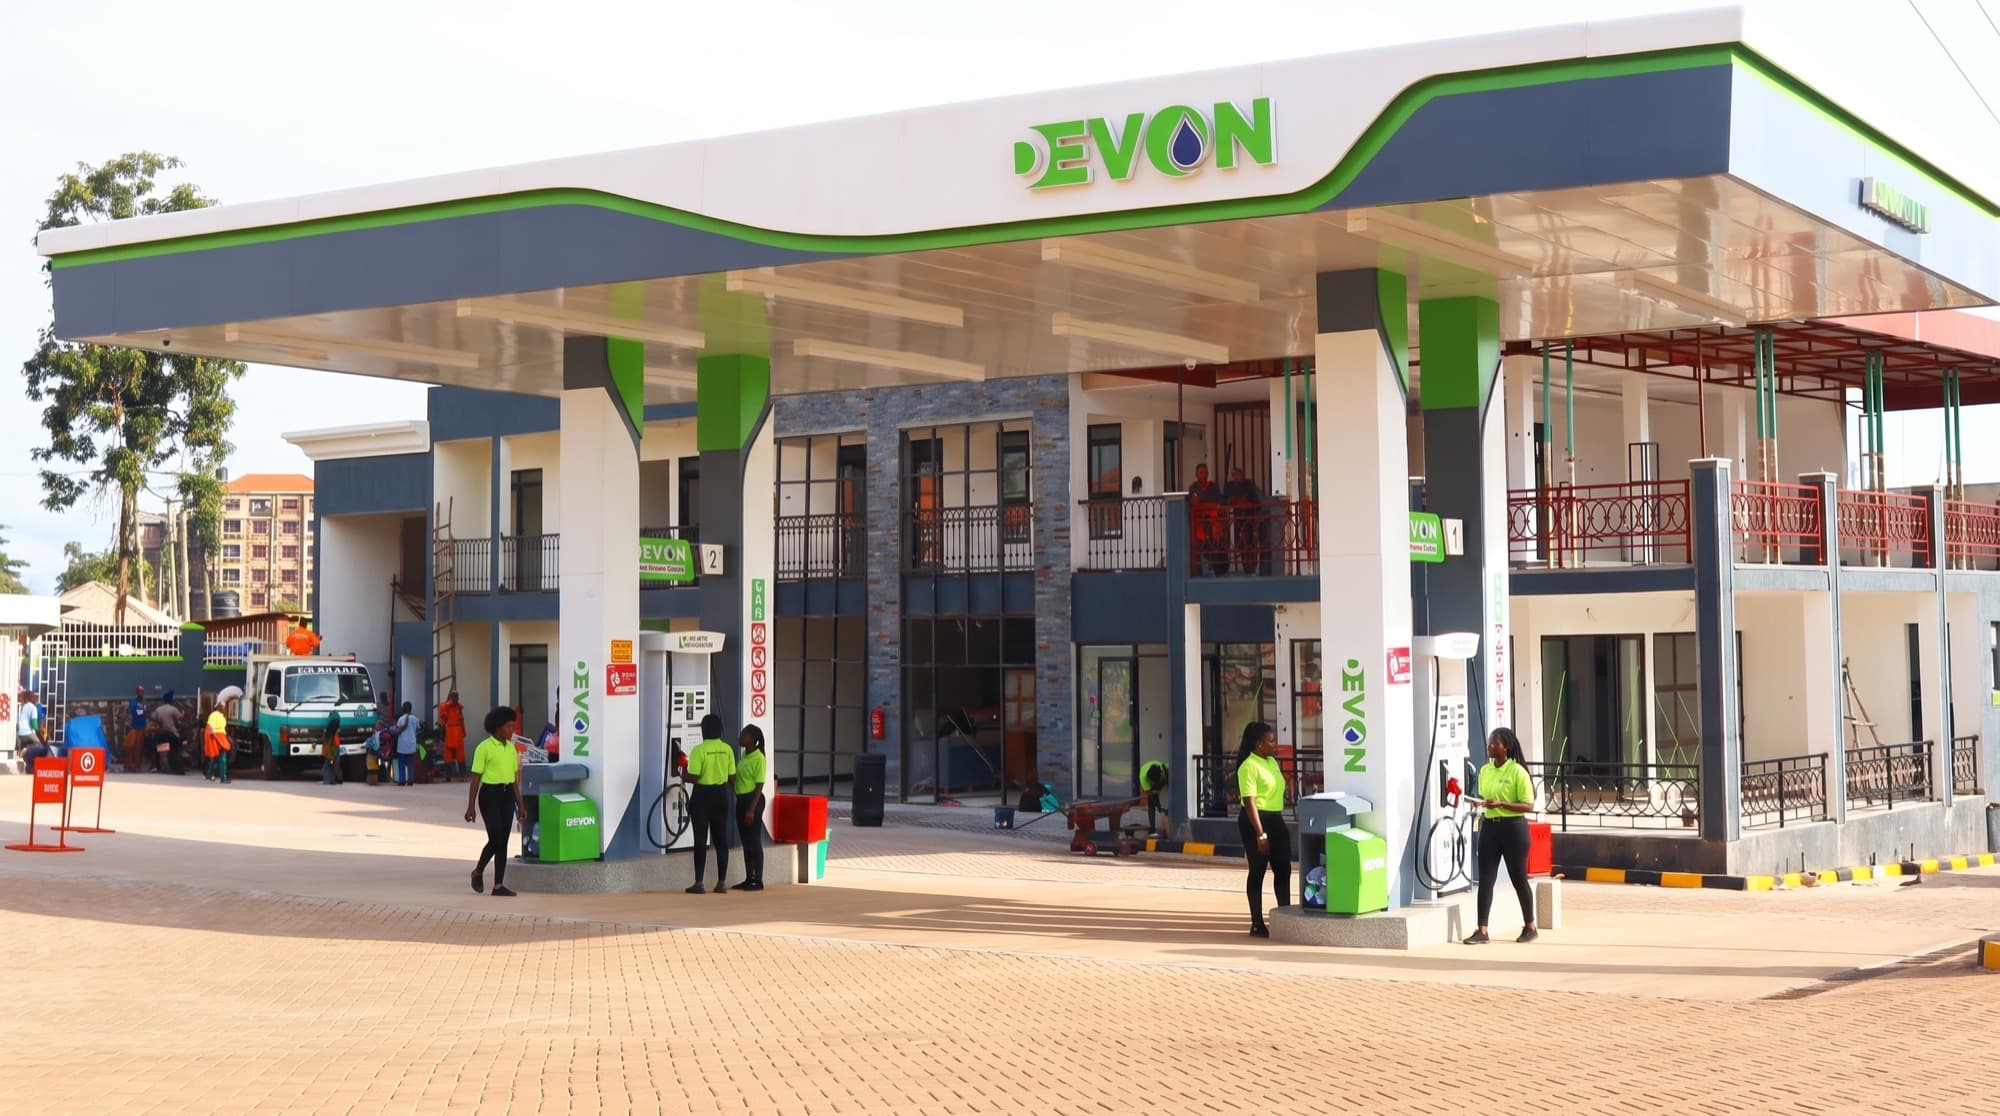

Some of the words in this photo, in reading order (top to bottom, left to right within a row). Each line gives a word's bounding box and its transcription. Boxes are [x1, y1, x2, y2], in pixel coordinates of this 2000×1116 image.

[1014, 97, 1277, 189] DEVON
[639, 544, 686, 562] EVON
[1410, 519, 1437, 539] VON
[709, 550, 717, 568] 2
[573, 661, 590, 756] DEVON
[1342, 659, 1366, 772] DEVON
